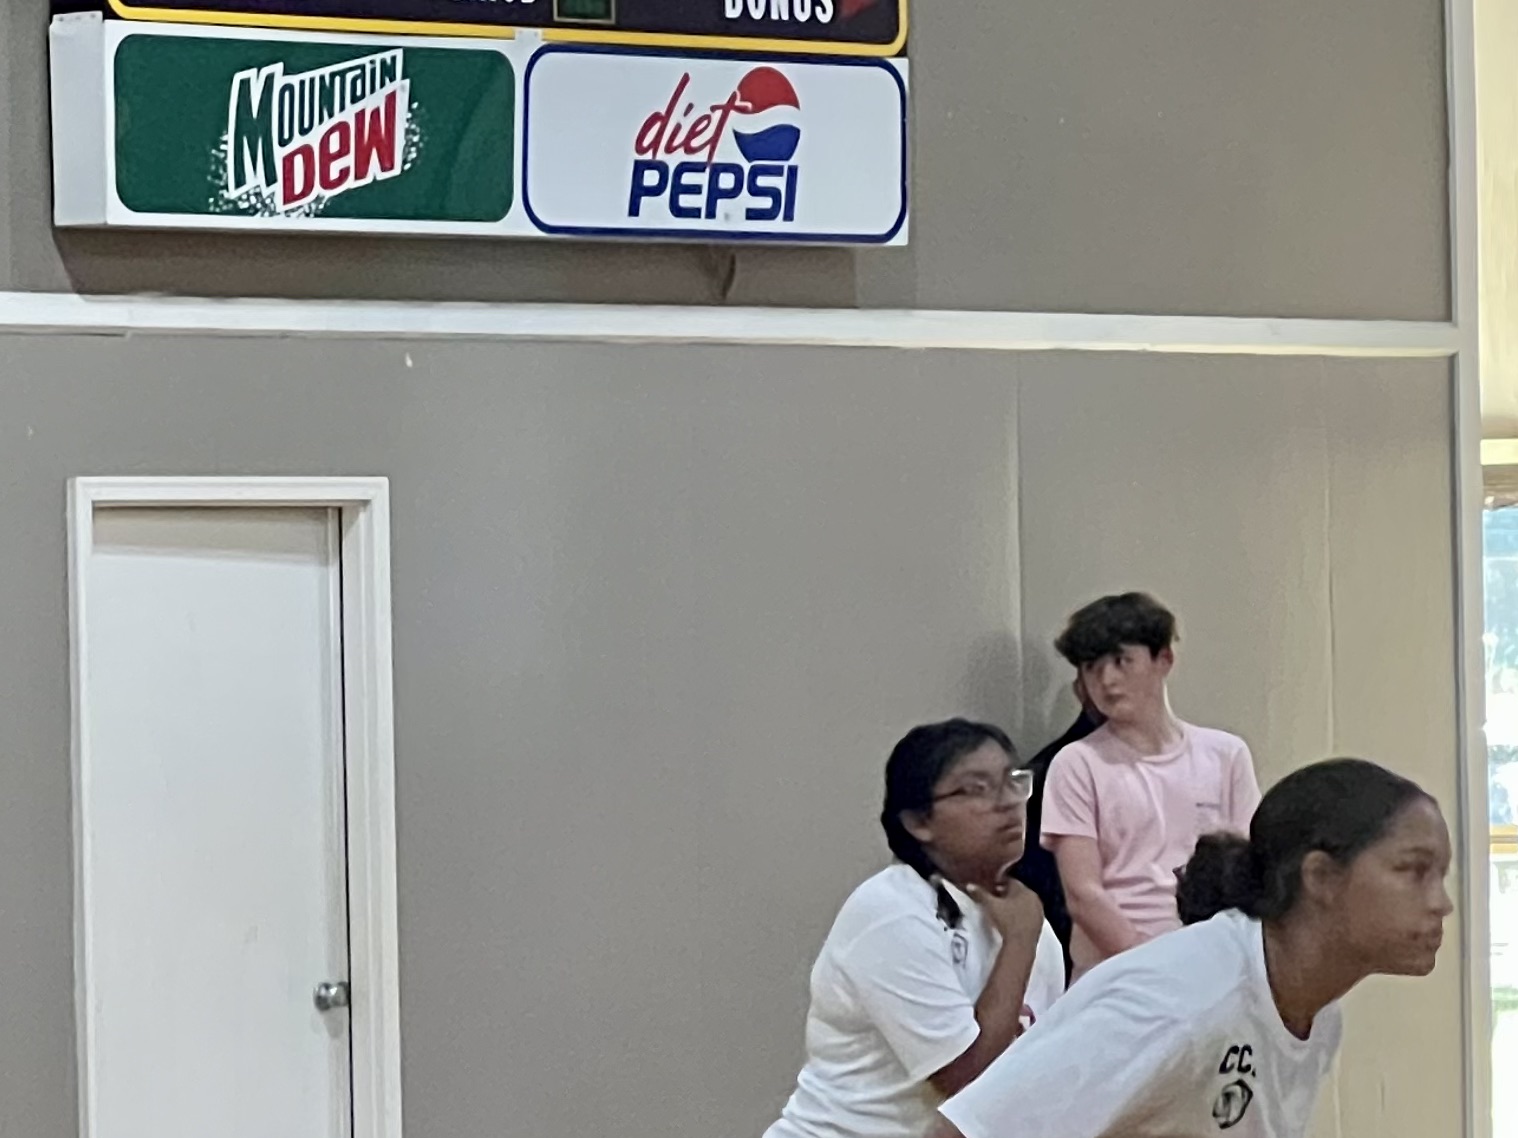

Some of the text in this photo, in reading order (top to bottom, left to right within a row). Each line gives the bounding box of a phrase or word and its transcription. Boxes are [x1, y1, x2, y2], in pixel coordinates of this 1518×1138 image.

[634, 72, 752, 166] diet
[628, 159, 799, 222] PEPSI
[1218, 1044, 1257, 1078] CC
